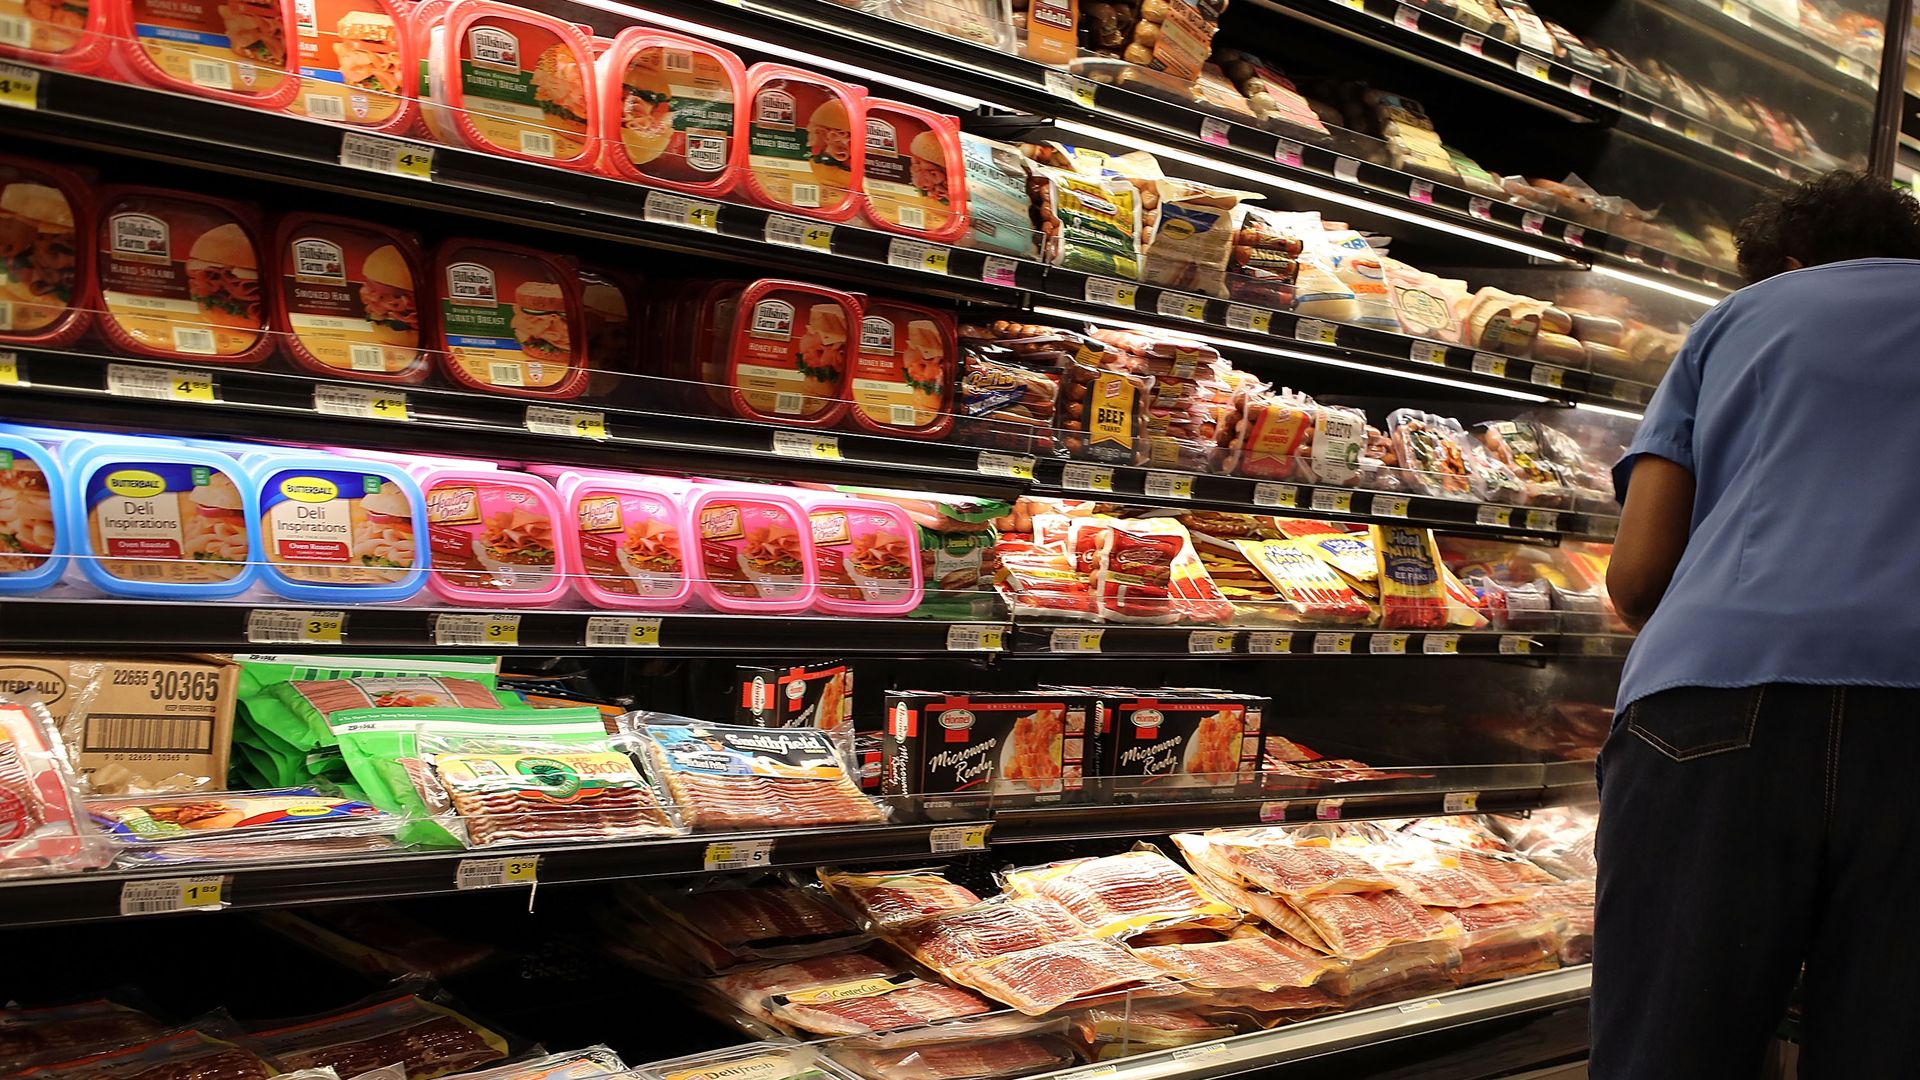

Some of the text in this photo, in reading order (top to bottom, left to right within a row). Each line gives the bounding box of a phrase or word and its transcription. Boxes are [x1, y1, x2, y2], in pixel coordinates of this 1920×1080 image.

[1034, 7, 1072, 27] aidells
[499, 78, 528, 93] BREAST
[866, 124, 893, 139] illshire
[117, 220, 162, 239] Hillshire
[118, 234, 146, 247] Farm
[299, 245, 337, 262] Hillshire
[300, 259, 324, 272] Farm
[452, 270, 489, 285] Hillshire
[453, 282, 477, 294] Farm
[444, 313, 505, 325] TURKEY BREAST
[759, 305, 790, 321] Hillshire
[757, 317, 776, 329] Farm
[1097, 407, 1125, 426] BEEF
[111, 478, 161, 489] BUTTERBALL
[286, 484, 333, 495] BUTTERBALL
[123, 501, 154, 515] Deli
[427, 491, 475, 513] Healthy
[296, 506, 325, 520] Deli
[580, 501, 618, 521] Healthy
[105, 516, 178, 531] Inspirations
[700, 509, 738, 530] Healthy
[277, 520, 348, 534] Inspirations
[118, 541, 170, 549] Oven Roasted
[310, 543, 340, 552] Roasted
[309, 621, 337, 633] 399
[490, 624, 515, 637] 399
[634, 626, 657, 637] 399
[113, 669, 219, 701] 22655 30365
[944, 714, 972, 725] Hormel
[1135, 714, 1159, 724] Hormel
[724, 733, 825, 755] Smithfield
[1119, 735, 1183, 767] Microwave
[114, 753, 124, 761] 00
[184, 753, 190, 762] 0
[928, 737, 998, 773] Microwave
[574, 761, 630, 775] BACON
[954, 752, 995, 783] Ready
[1142, 748, 1179, 777] Ready
[510, 862, 534, 875] 359
[187, 886, 217, 899] 189
